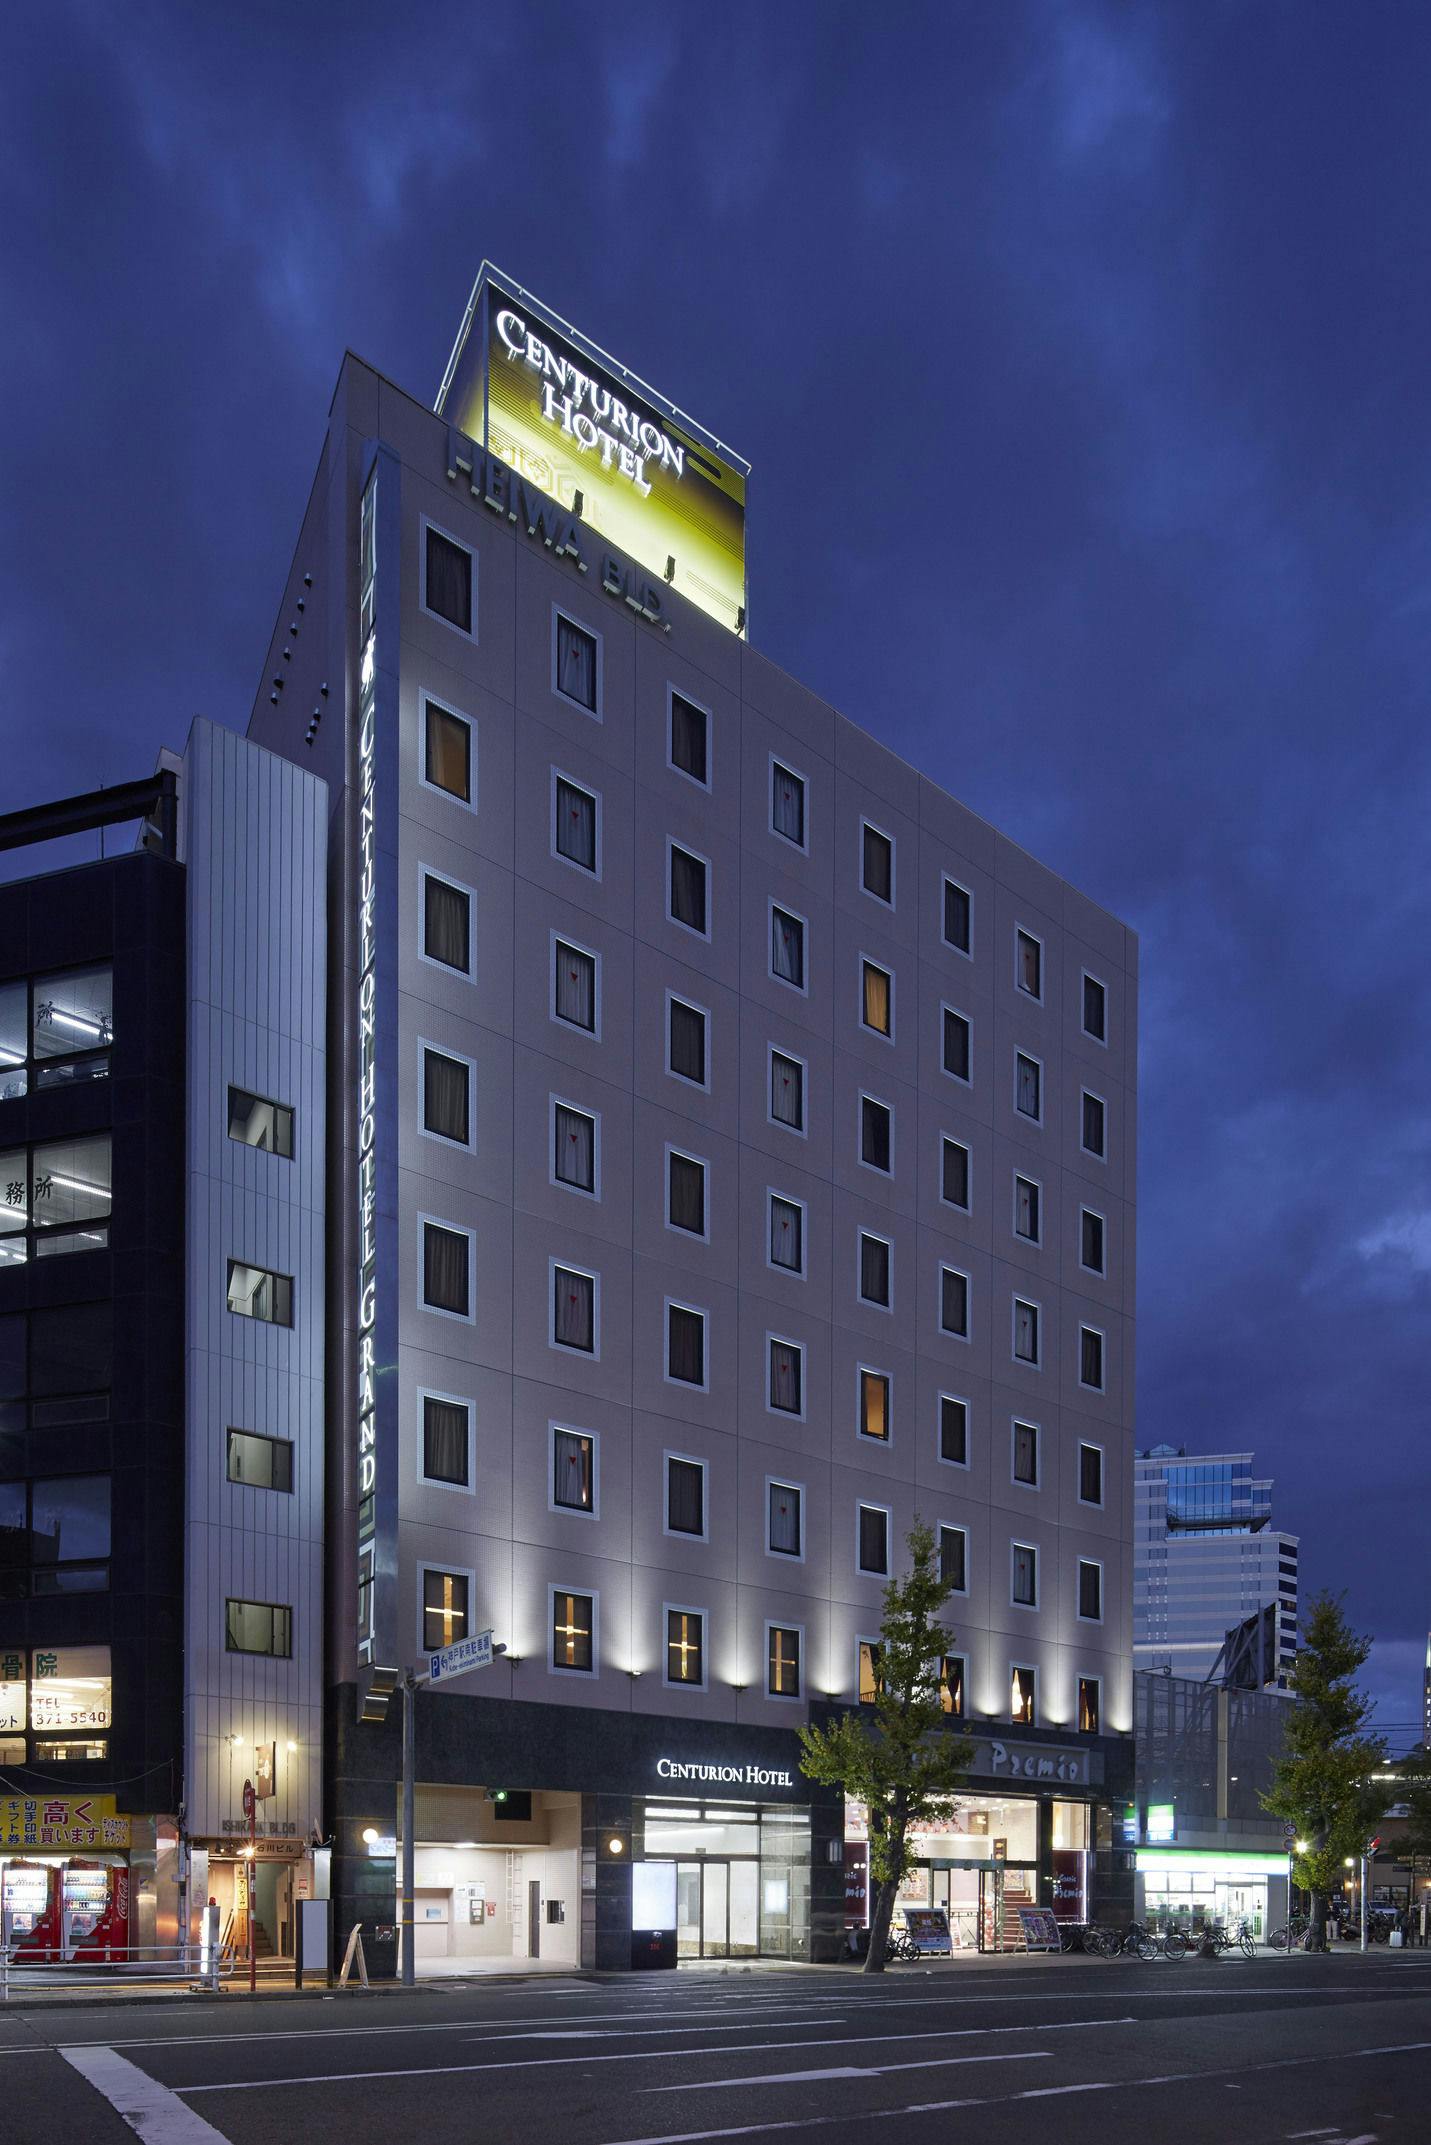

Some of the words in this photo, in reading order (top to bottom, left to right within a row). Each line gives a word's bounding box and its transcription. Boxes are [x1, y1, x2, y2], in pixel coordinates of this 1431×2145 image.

[496, 309, 685, 475] CENTURION
[543, 381, 652, 491] HOTEL
[447, 426, 588, 572] HEIWA
[359, 701, 376, 1049] CENTURION
[359, 1060, 376, 1263] HOTEL
[359, 1281, 376, 1492] GRAND
[36, 1698, 60, 1709] TEL
[656, 1759, 743, 1783] CENTURION
[746, 1766, 793, 1786] HOTEL
[7, 1801, 20, 1845] ギフト券
[24, 1800, 37, 1844] 切手印紙
[40, 1827, 100, 1844] 買います
[43, 1801, 94, 1825] 高く
